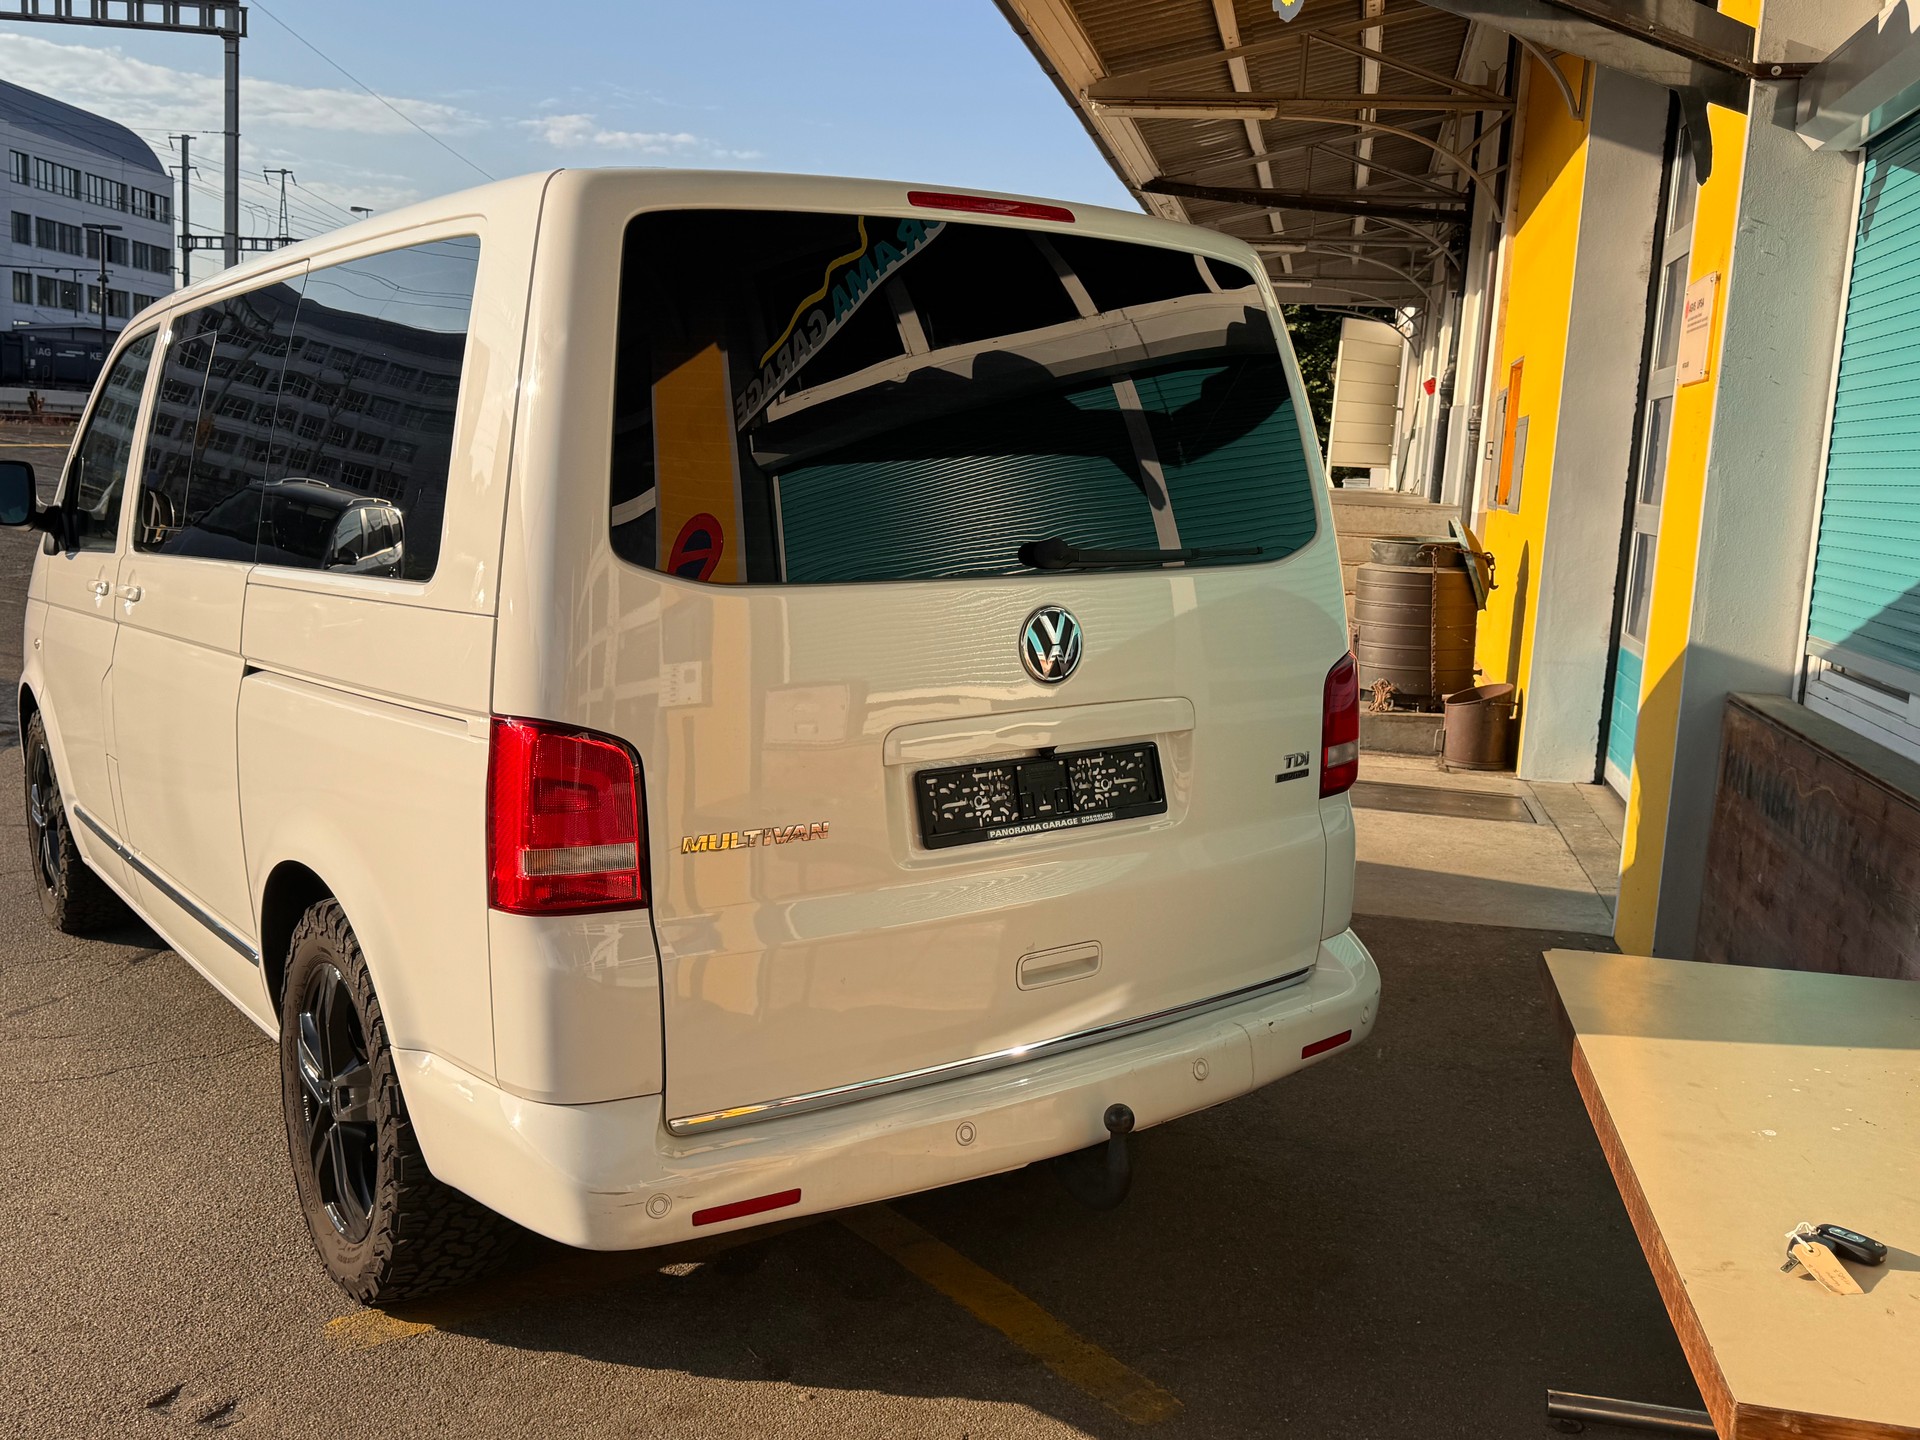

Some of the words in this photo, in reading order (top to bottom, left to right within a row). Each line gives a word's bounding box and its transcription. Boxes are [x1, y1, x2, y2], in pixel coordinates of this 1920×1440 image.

[1022, 606, 1081, 682] VW
[680, 820, 831, 855] MULTIVAN
[990, 824, 1042, 838] PANORAMA
[1043, 818, 1078, 829] GARAGE
